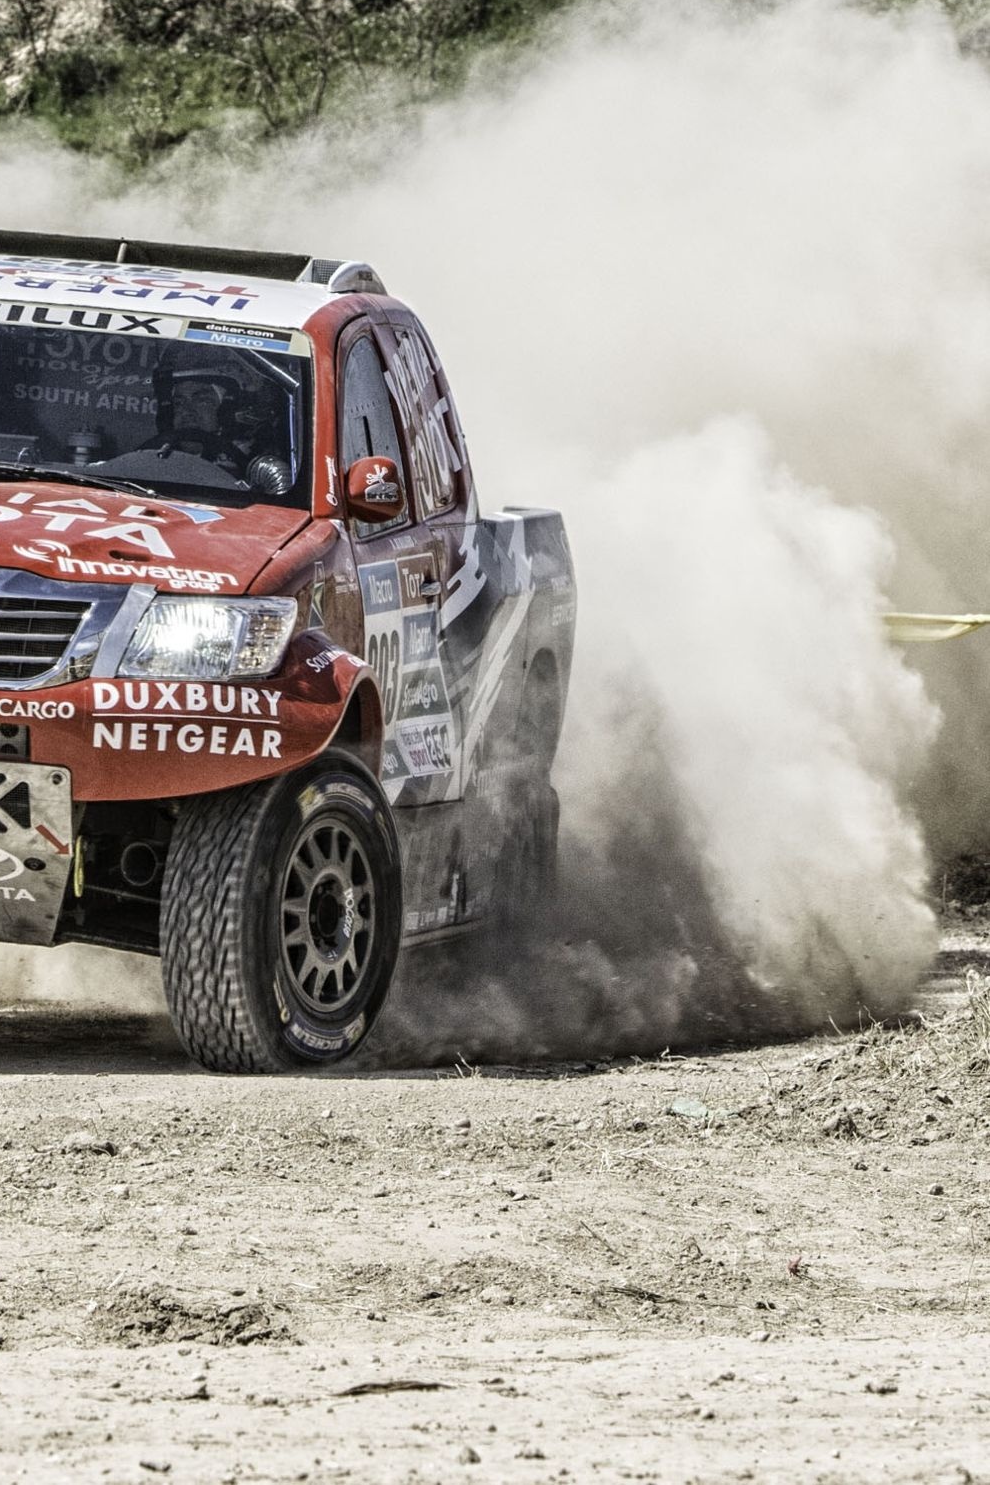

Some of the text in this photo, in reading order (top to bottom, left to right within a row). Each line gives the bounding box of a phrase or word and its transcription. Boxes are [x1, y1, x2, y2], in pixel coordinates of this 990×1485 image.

[205, 322, 275, 339] dakar.com
[210, 332, 264, 348] Macro
[14, 383, 159, 415] SOUTH AFRIC
[168, 579, 221, 593] group
[368, 575, 393, 605] Macro
[401, 568, 425, 599] TOT
[92, 682, 283, 717] DUXBURY
[92, 722, 283, 759] NETGEAR
